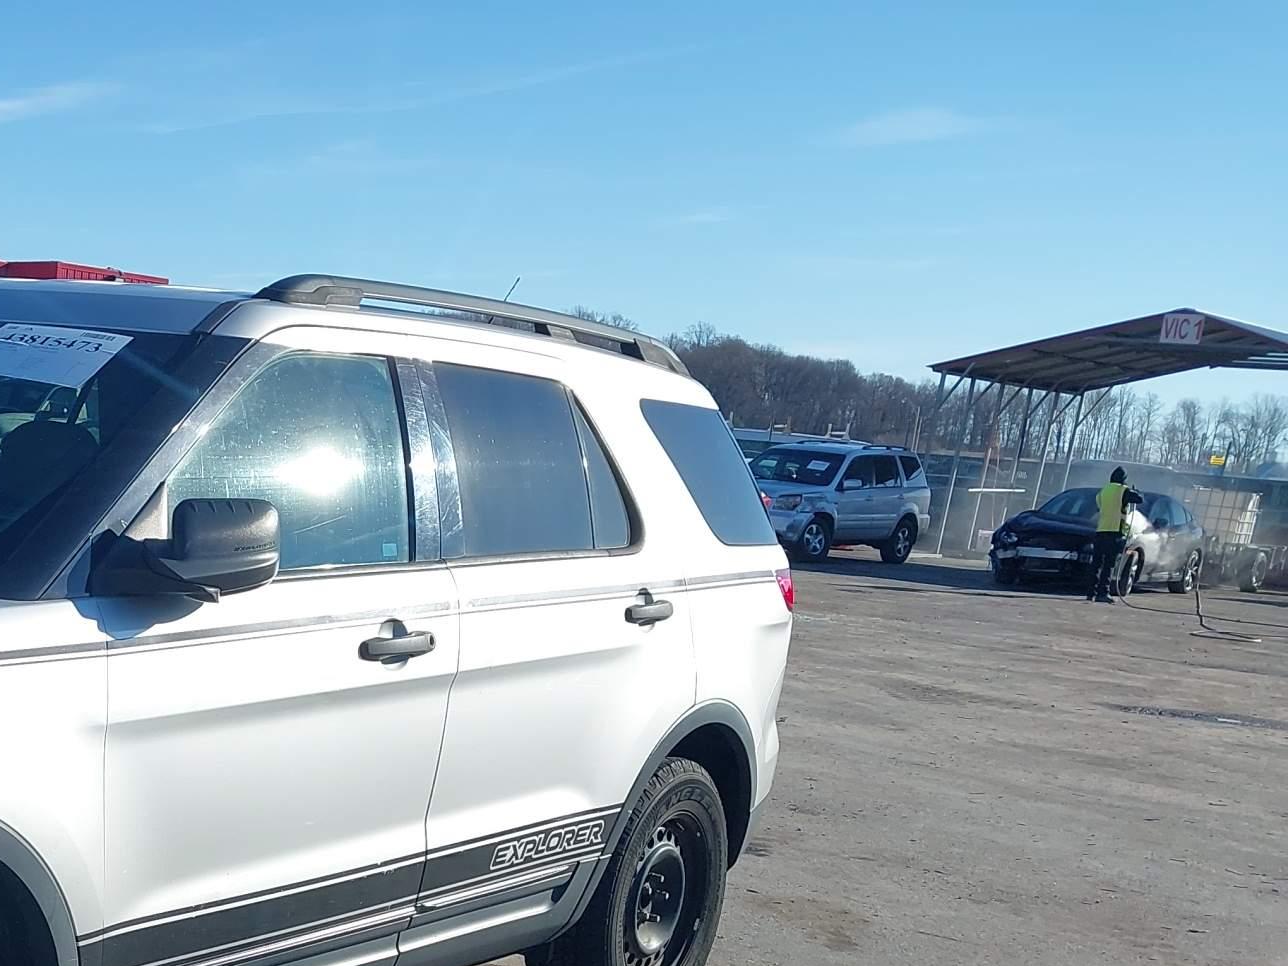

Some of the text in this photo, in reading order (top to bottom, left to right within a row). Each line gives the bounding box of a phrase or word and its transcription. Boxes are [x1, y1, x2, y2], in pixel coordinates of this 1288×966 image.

[1164, 317, 1203, 340] VIC 1
[490, 819, 605, 870] EXPLORER
